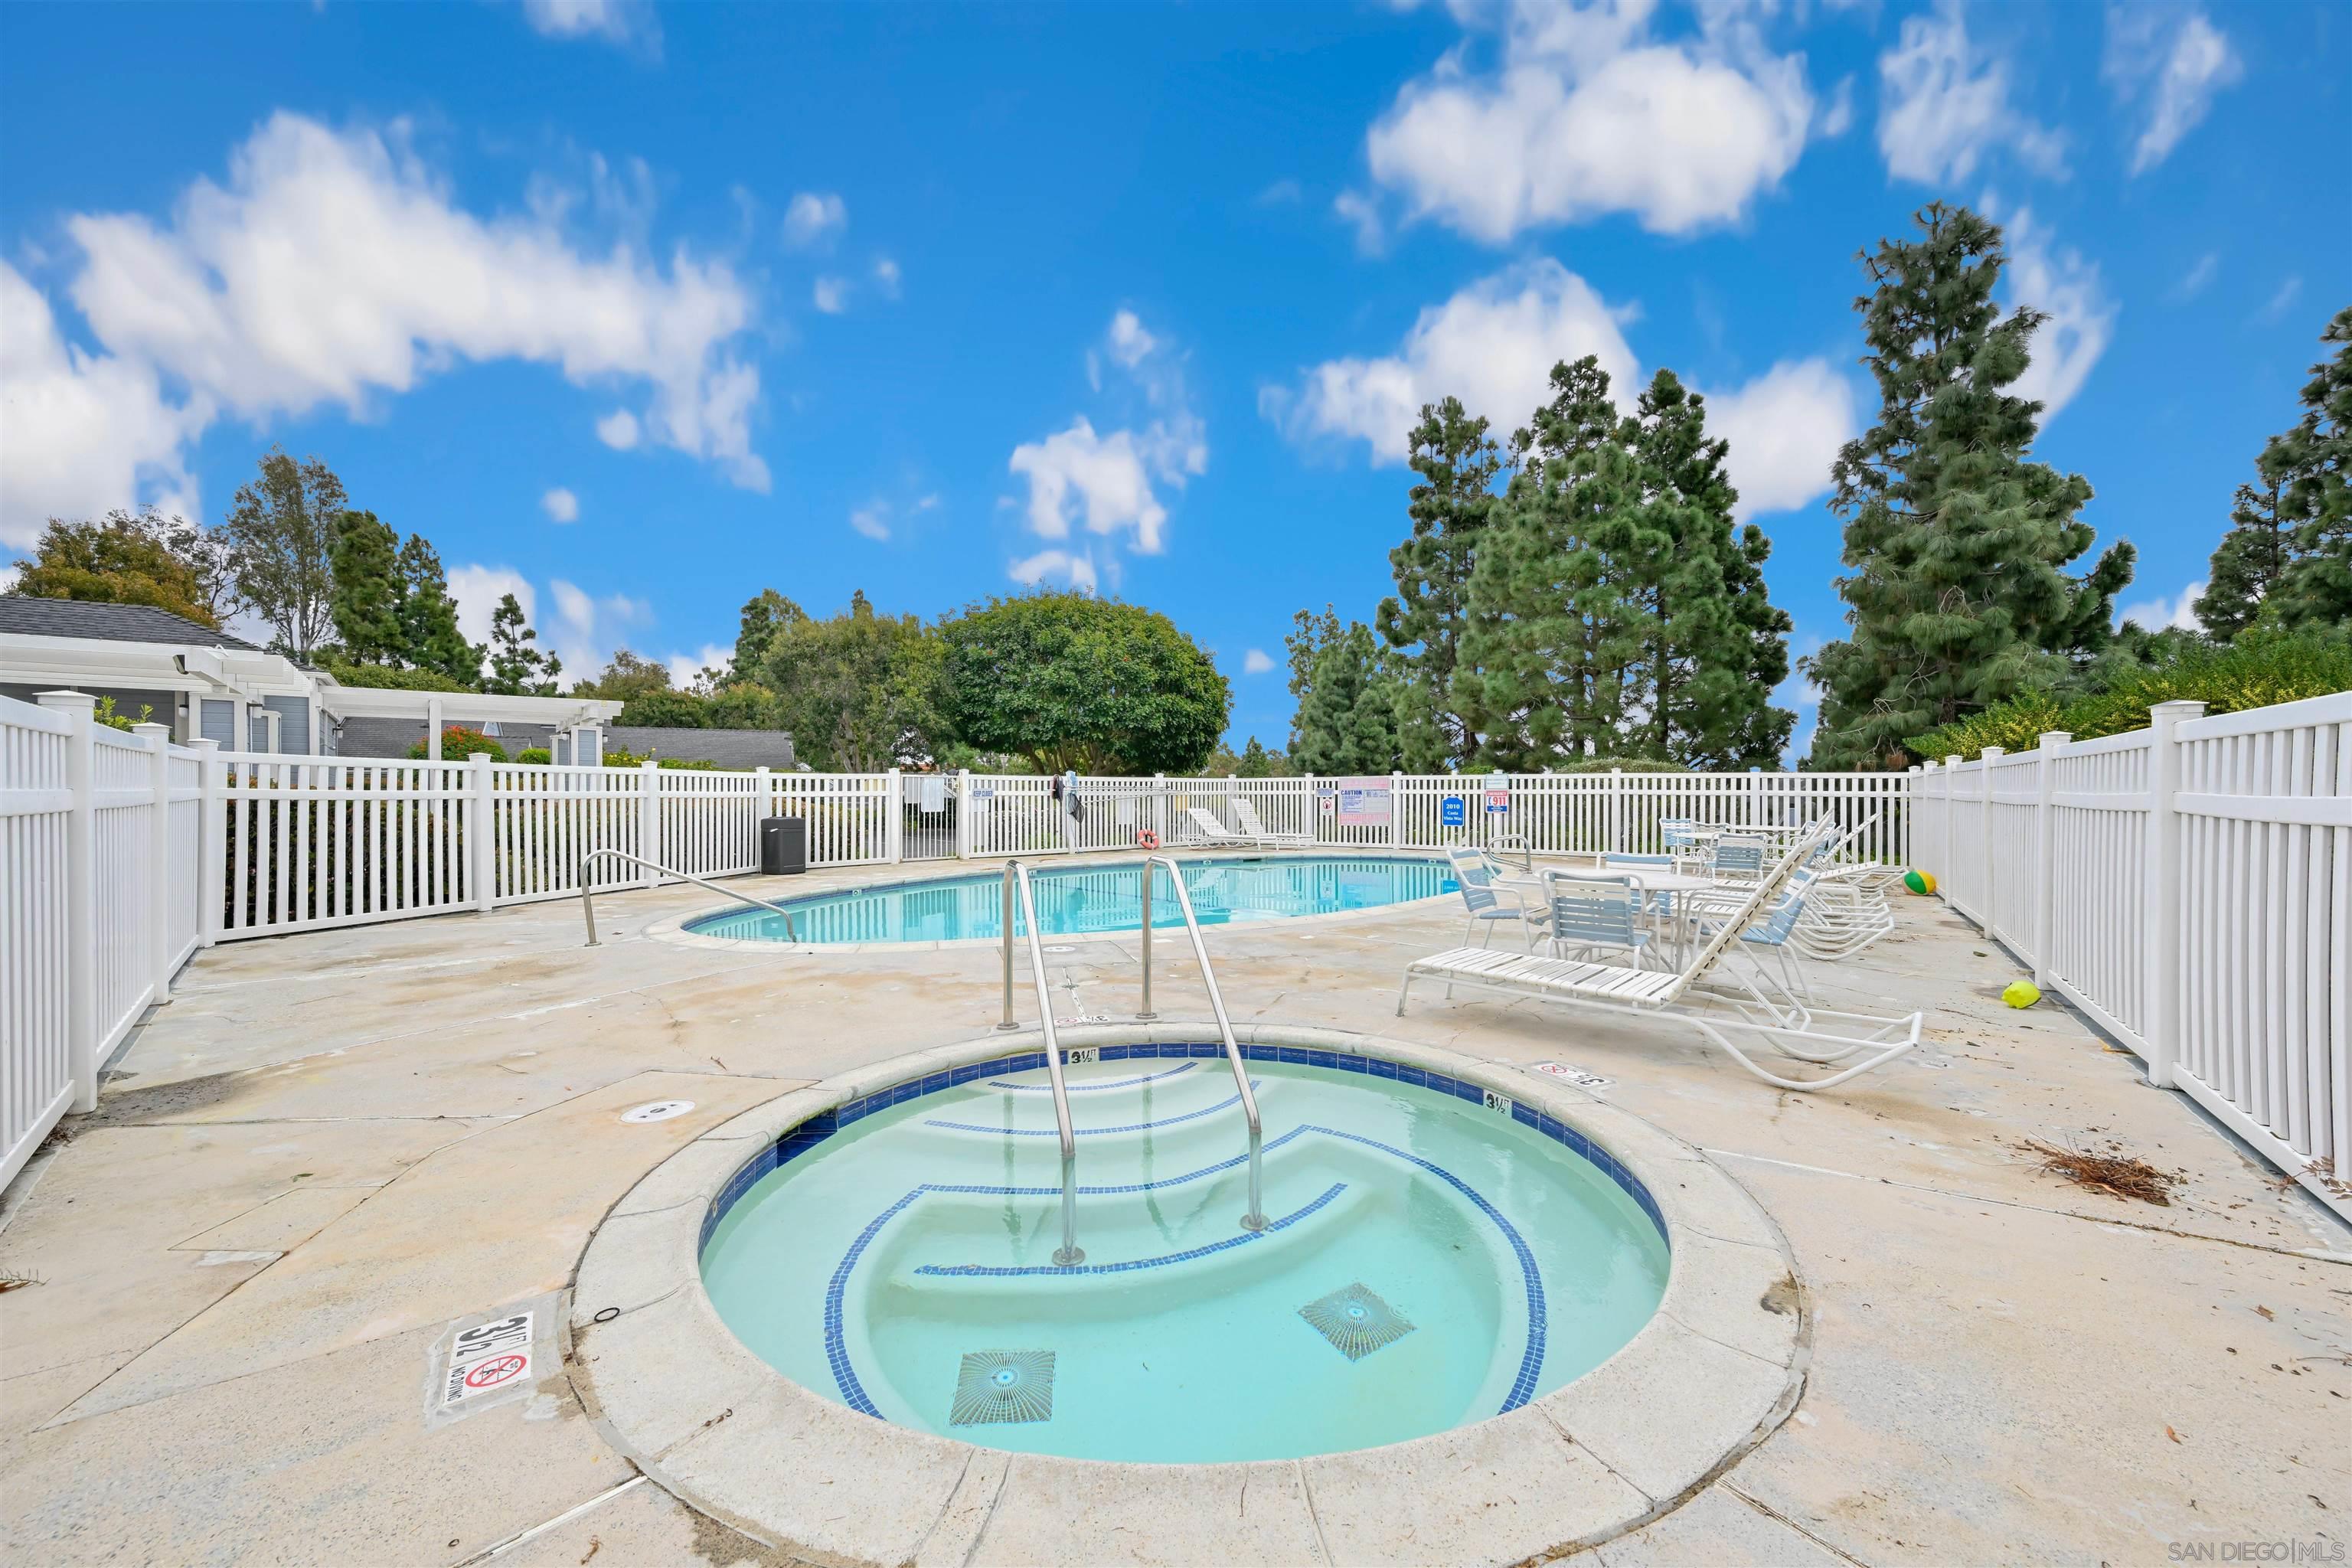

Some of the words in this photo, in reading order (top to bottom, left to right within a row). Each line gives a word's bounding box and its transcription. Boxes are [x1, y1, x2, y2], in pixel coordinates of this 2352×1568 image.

[1493, 797, 1506, 805] 911
[451, 1366, 466, 1377] NO
[447, 1377, 465, 1402] DIVING
